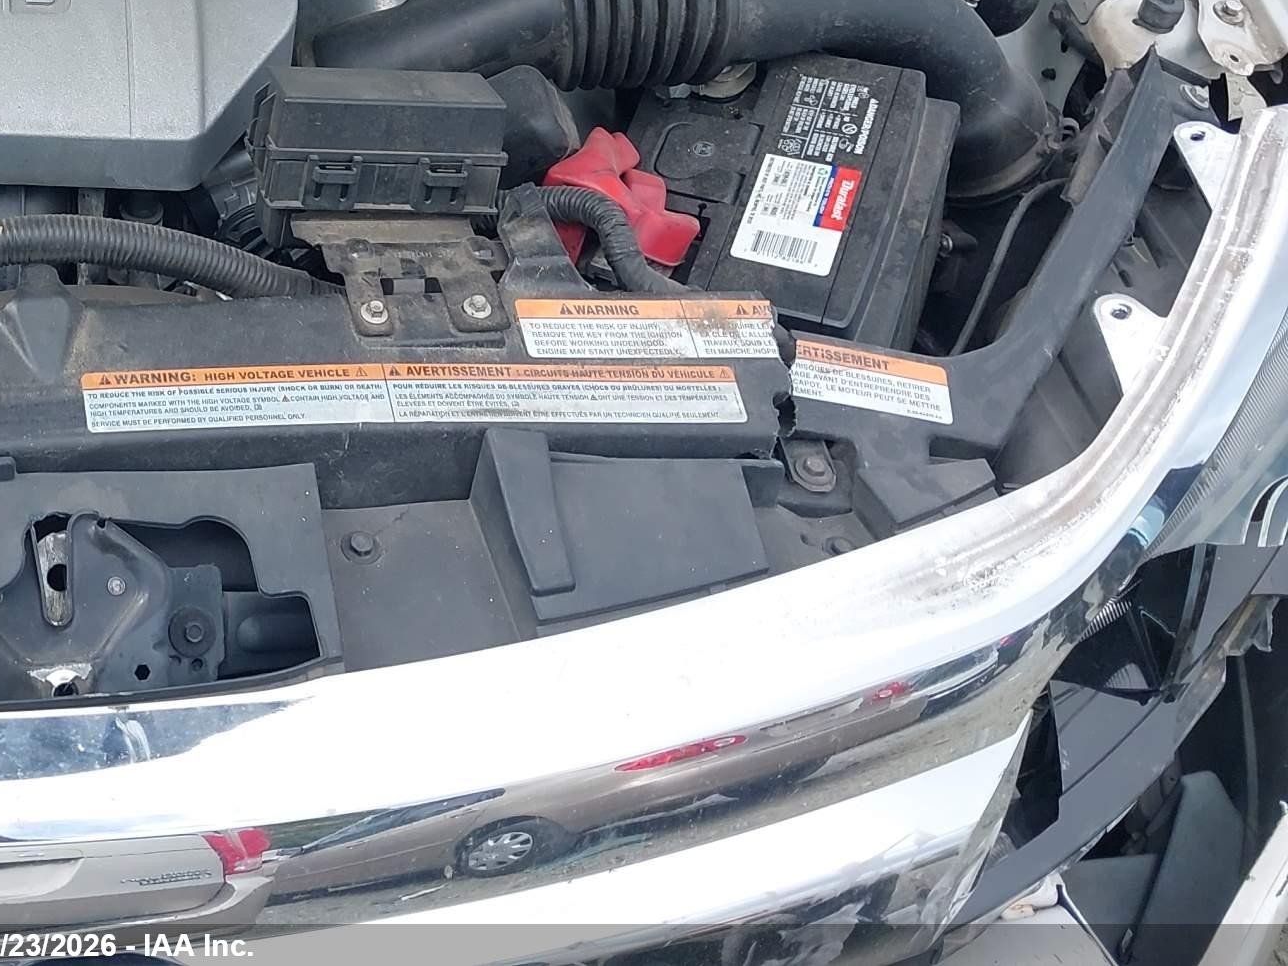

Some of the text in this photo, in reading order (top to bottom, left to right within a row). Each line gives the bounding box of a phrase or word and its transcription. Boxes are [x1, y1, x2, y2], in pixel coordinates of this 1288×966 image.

[829, 178, 854, 220] Duralast
[573, 305, 640, 315] WARNING
[113, 368, 350, 385] WARNING: HIGH VOLTAGE VEHICLE
[405, 365, 513, 376] AVERTISSEMENT
[523, 369, 569, 377] CIRCUITS
[571, 369, 604, 377] HAUTE
[606, 369, 649, 378] TENSION
[650, 370, 665, 378] DU
[795, 360, 830, 374] RISQUES
[832, 368, 843, 376] DE
[896, 380, 931, 393] RETIRER
[249, 385, 276, 393] INJURY
[812, 373, 837, 384] AVANT
[914, 393, 930, 401] DES
[88, 401, 136, 409] COMPONENTS
[289, 394, 319, 402] CONTAIN
[825, 383, 836, 392] LE
[838, 385, 872, 399] MOTEUR
[874, 392, 894, 403] PEUT
[896, 397, 906, 405] SE
[908, 399, 941, 412] METTRE
[108, 408, 162, 416] TEMPERATURES
[245, 413, 286, 421] PERSONNEL
